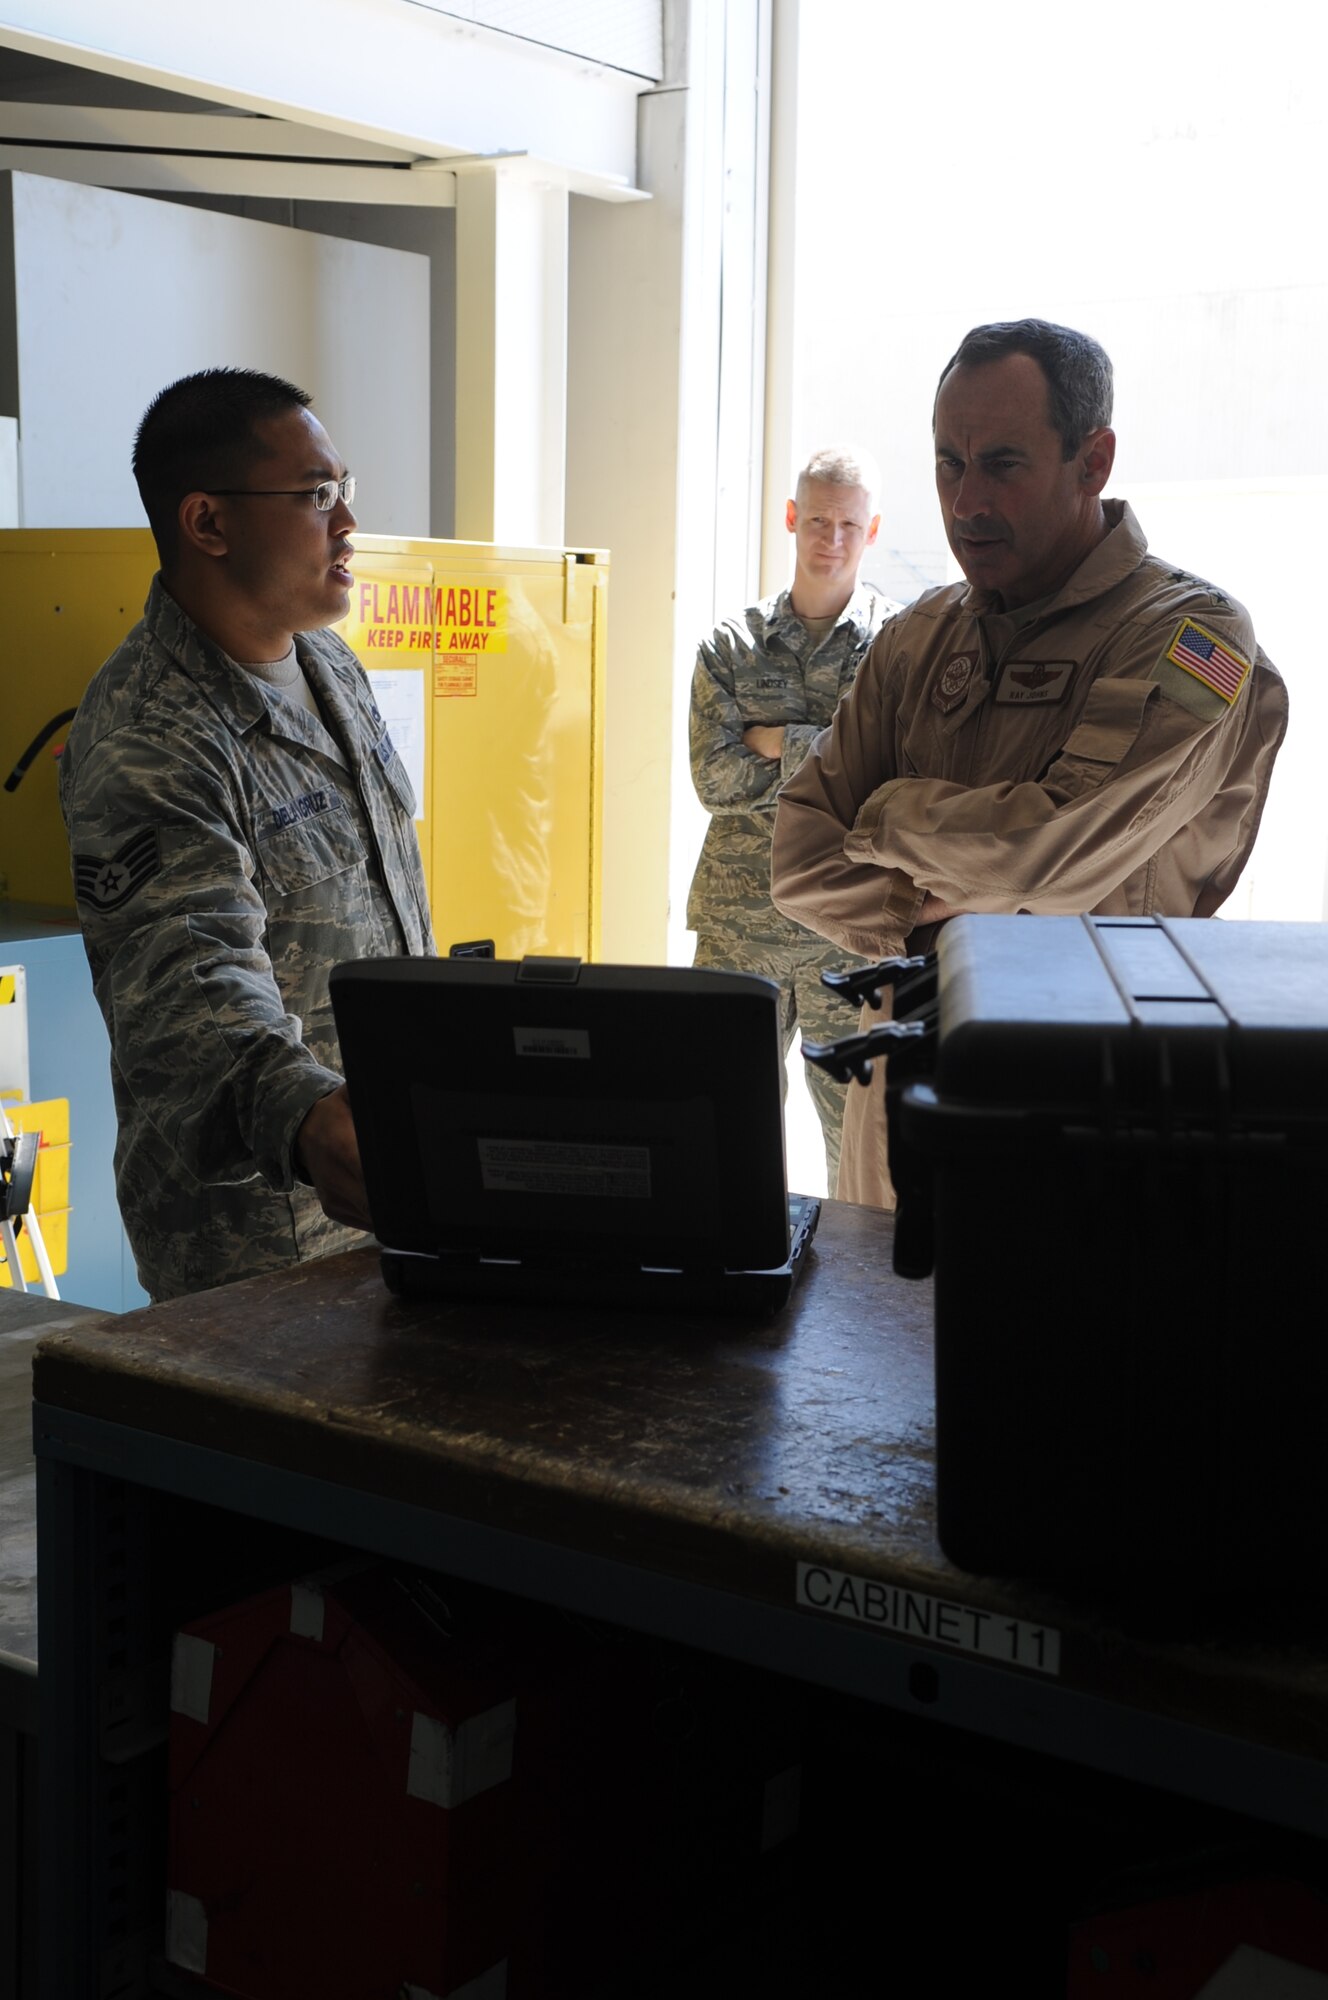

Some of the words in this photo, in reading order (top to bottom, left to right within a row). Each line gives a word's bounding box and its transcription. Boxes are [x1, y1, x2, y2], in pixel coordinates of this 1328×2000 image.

[359, 582, 497, 627] FLAMMABLE
[367, 629, 404, 648] KEEP
[409, 631, 442, 649] FIRE
[449, 632, 489, 650] AWAY
[803, 1567, 992, 1650] CABINET
[1005, 1621, 1045, 1667] 11
